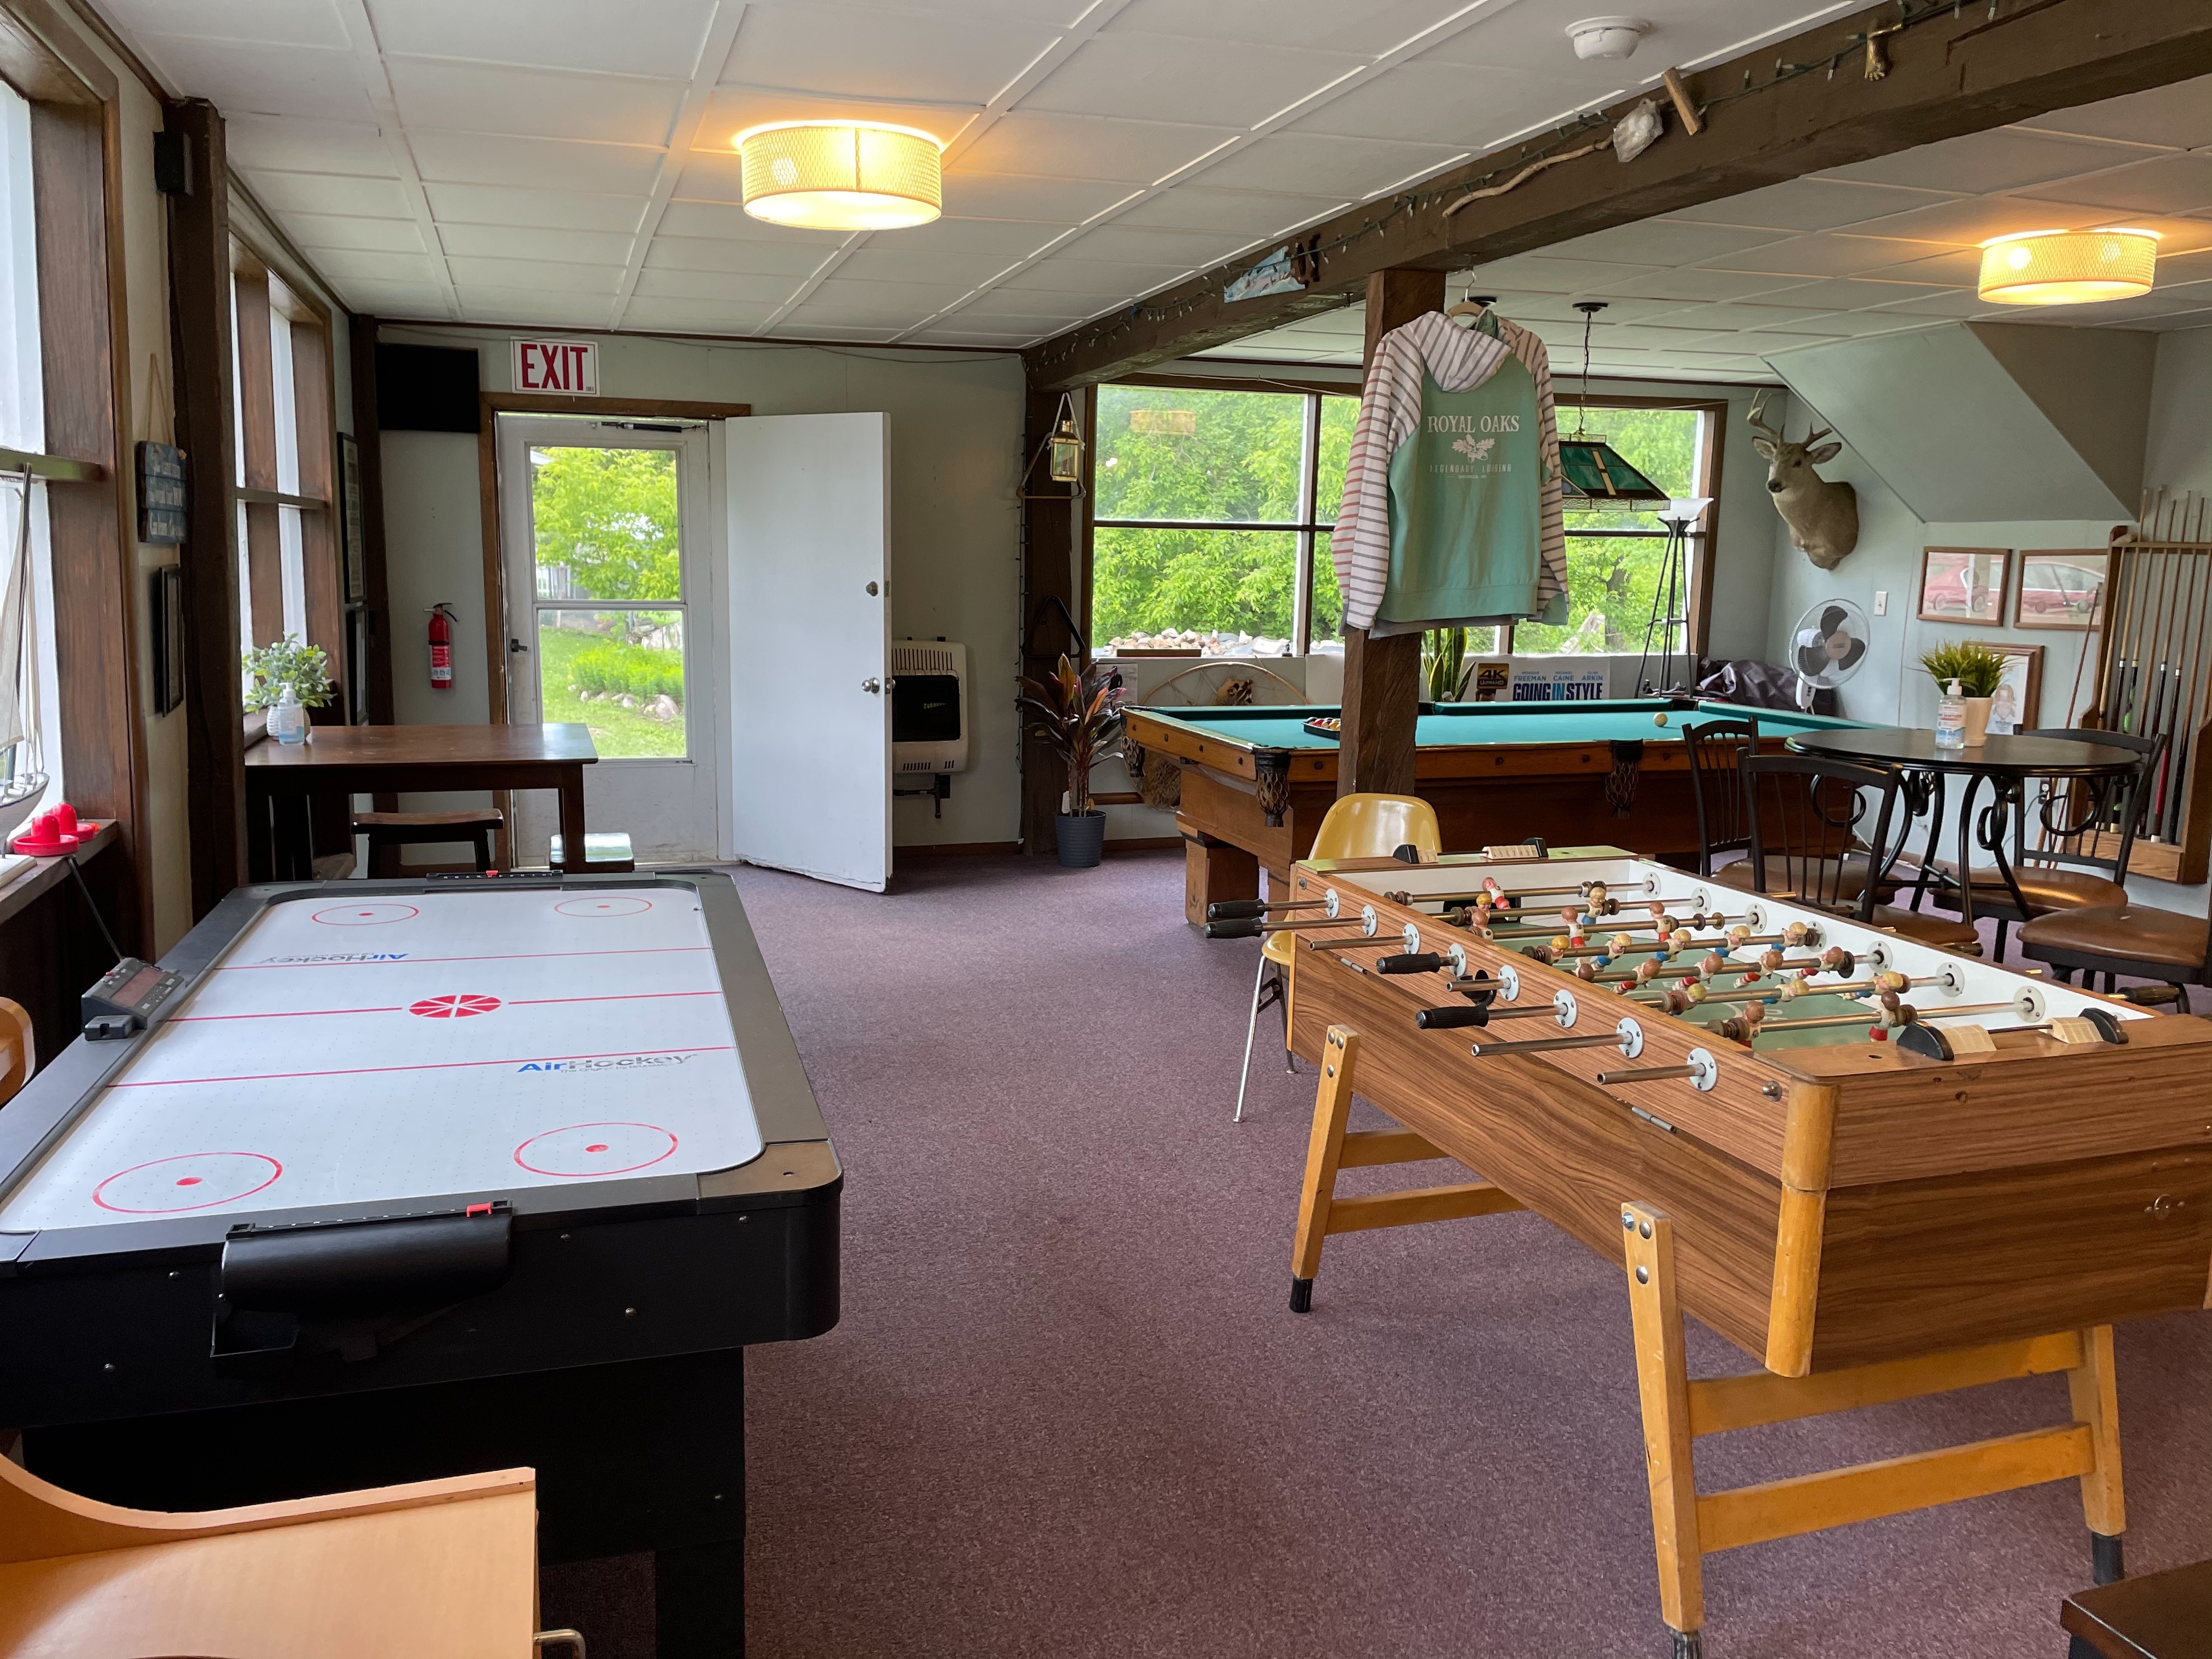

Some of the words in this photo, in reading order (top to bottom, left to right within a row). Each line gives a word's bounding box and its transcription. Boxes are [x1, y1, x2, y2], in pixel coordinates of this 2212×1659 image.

[521, 343, 588, 391] EXIT
[1427, 415, 1476, 433] ROYAL
[1480, 415, 1520, 432] OAKS
[1430, 464, 1475, 473] LEGENDARY
[1480, 669, 1506, 679] 4K
[1513, 683, 1551, 701] GOING
[1552, 683, 1565, 701] IN
[1566, 682, 1603, 700] STYLE
[259, 953, 409, 963] AirHockey
[517, 1055, 693, 1073] AirHockey
